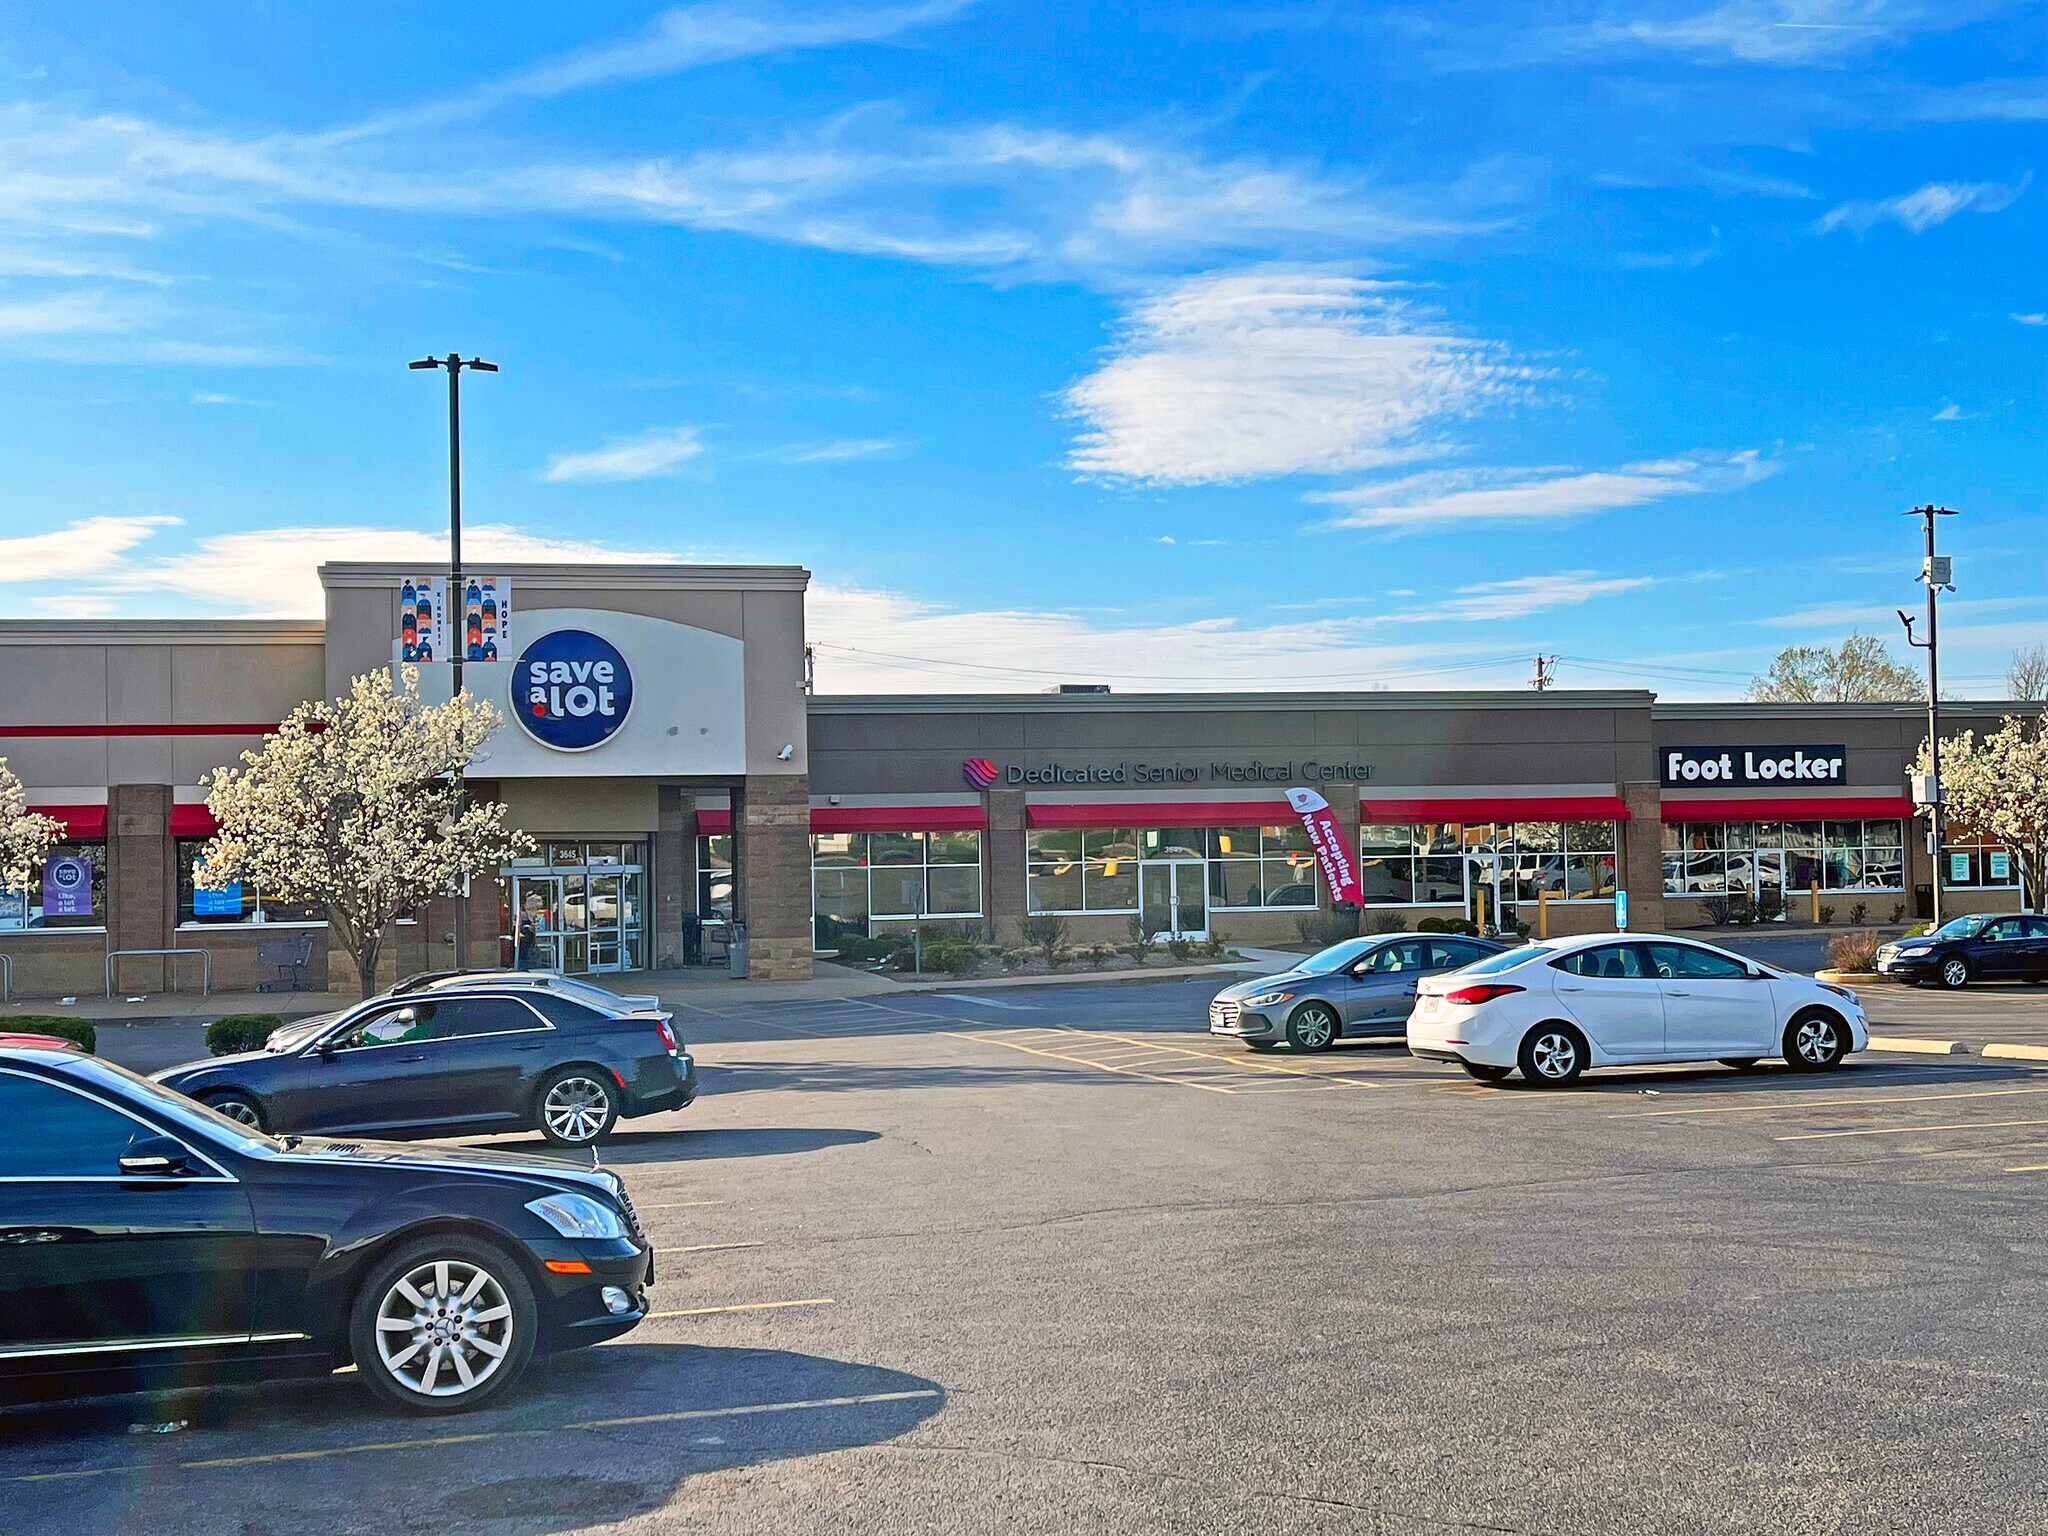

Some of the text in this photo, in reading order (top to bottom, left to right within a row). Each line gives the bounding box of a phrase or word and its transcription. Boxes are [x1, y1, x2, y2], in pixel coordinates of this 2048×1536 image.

[529, 660, 614, 684] save
[529, 686, 547, 704] a
[1006, 760, 1375, 784] Dedicated Senior Medical Center
[1668, 751, 1842, 781] Foot Locker
[559, 849, 577, 859] 3645
[1301, 813, 1321, 845] New
[1316, 845, 1343, 902] Patients
[1319, 819, 1354, 887] Accepting
